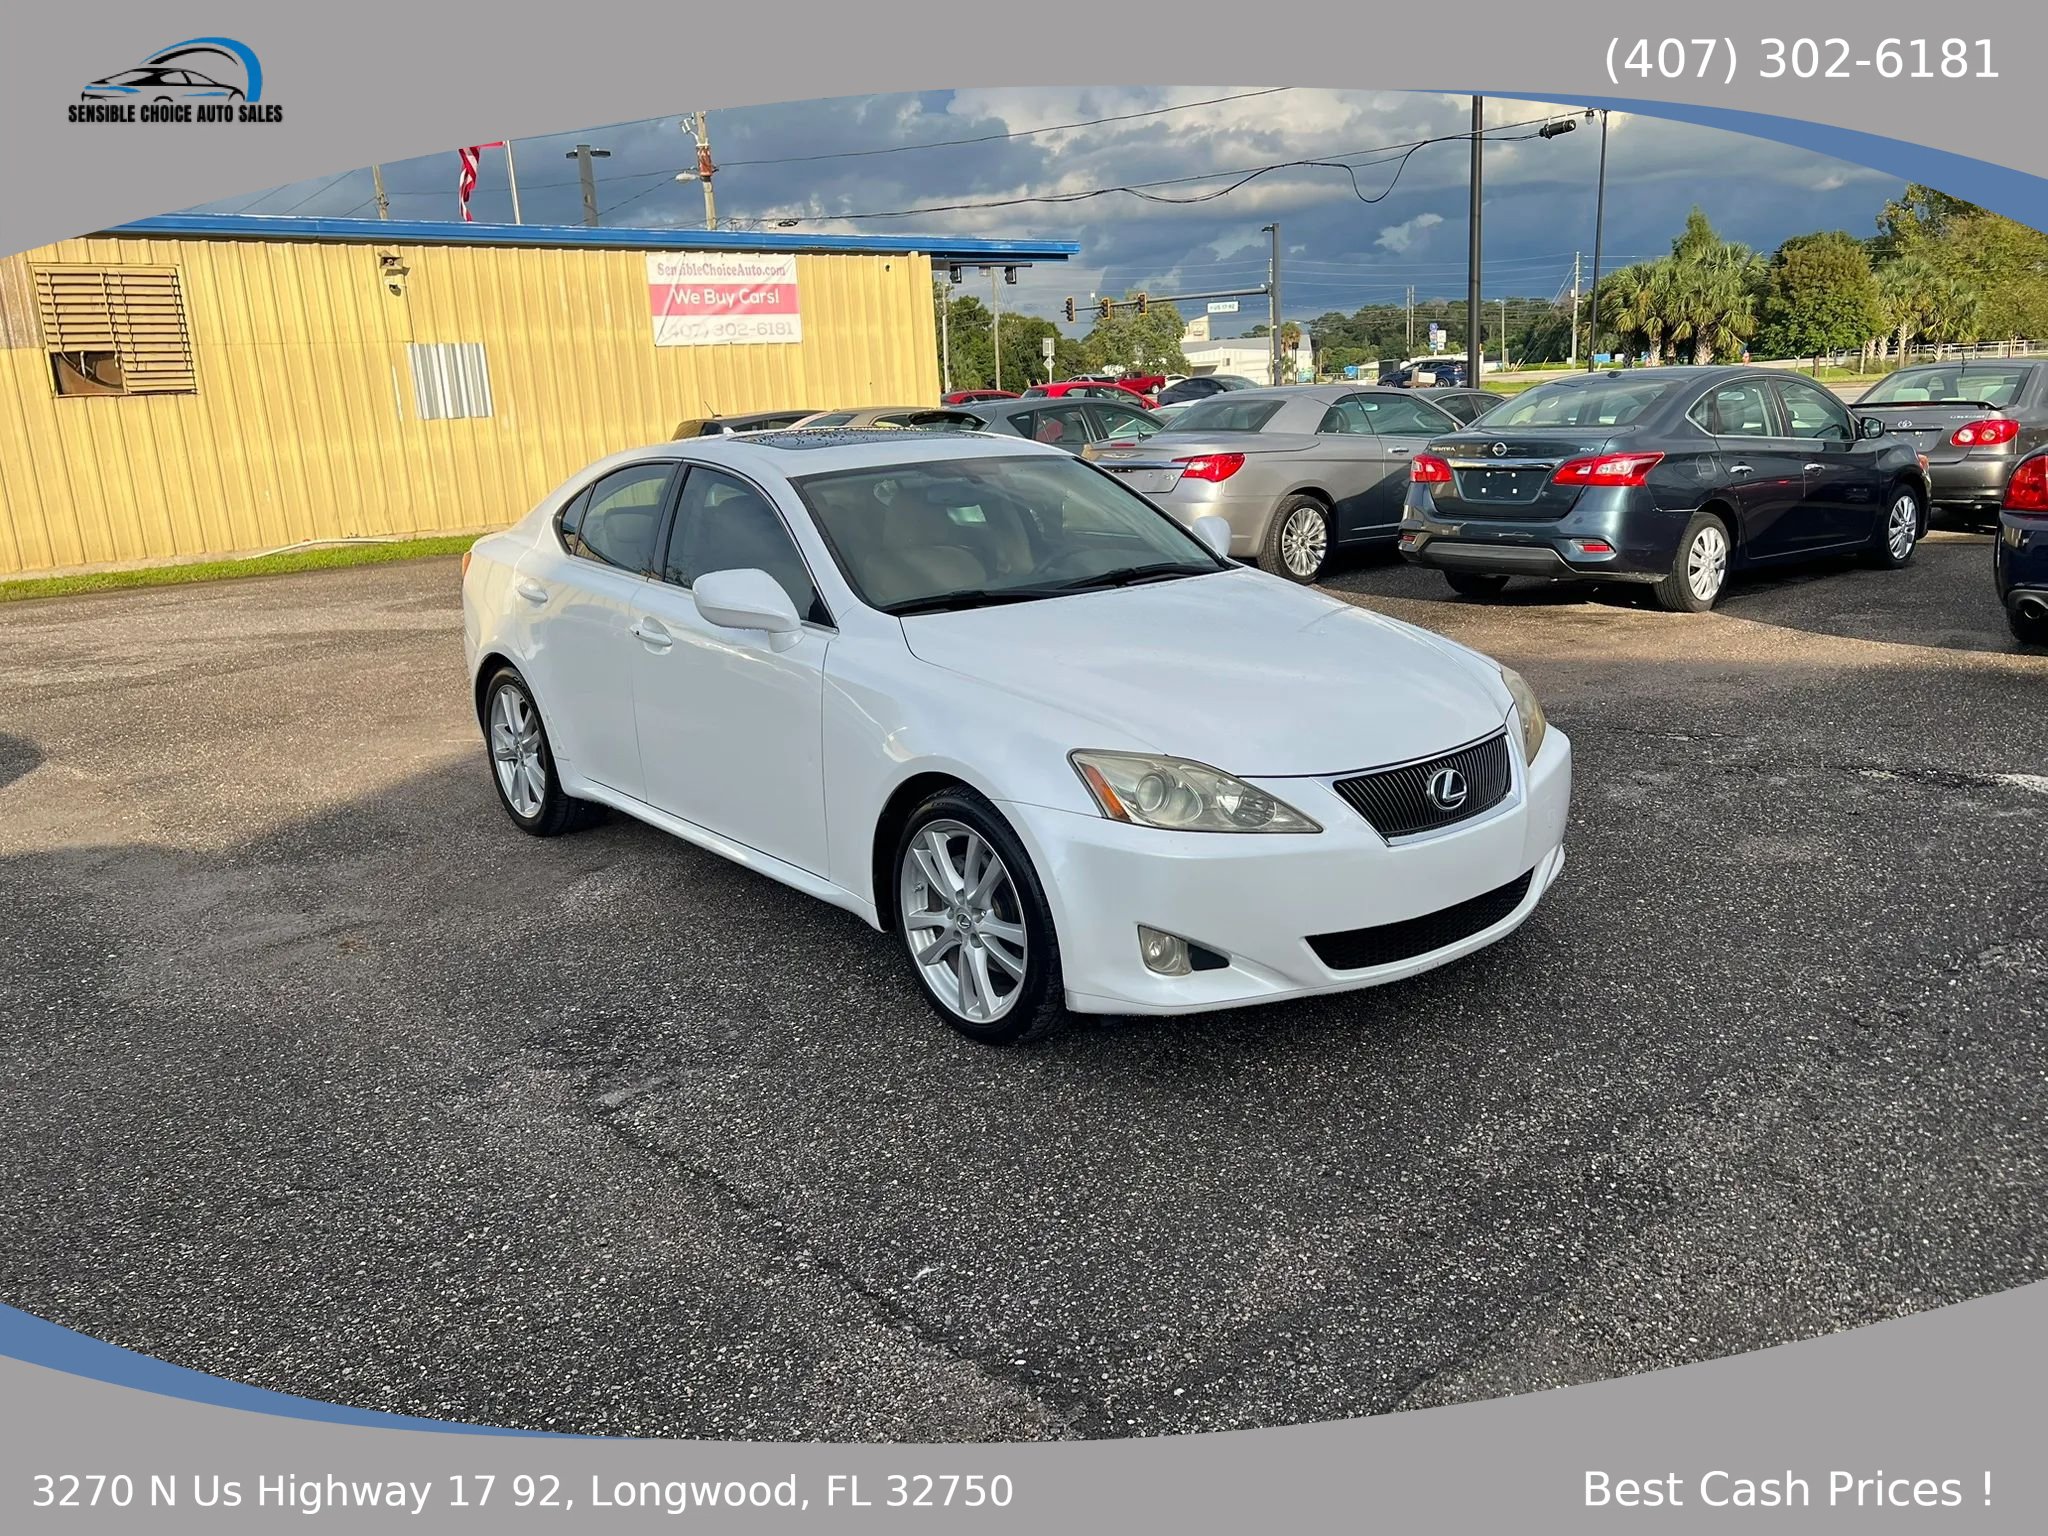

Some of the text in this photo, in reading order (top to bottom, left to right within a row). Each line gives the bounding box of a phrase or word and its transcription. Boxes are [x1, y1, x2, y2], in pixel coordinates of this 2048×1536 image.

[673, 288, 780, 308] We Buy Cars!
[713, 322, 794, 337] 302-6181
